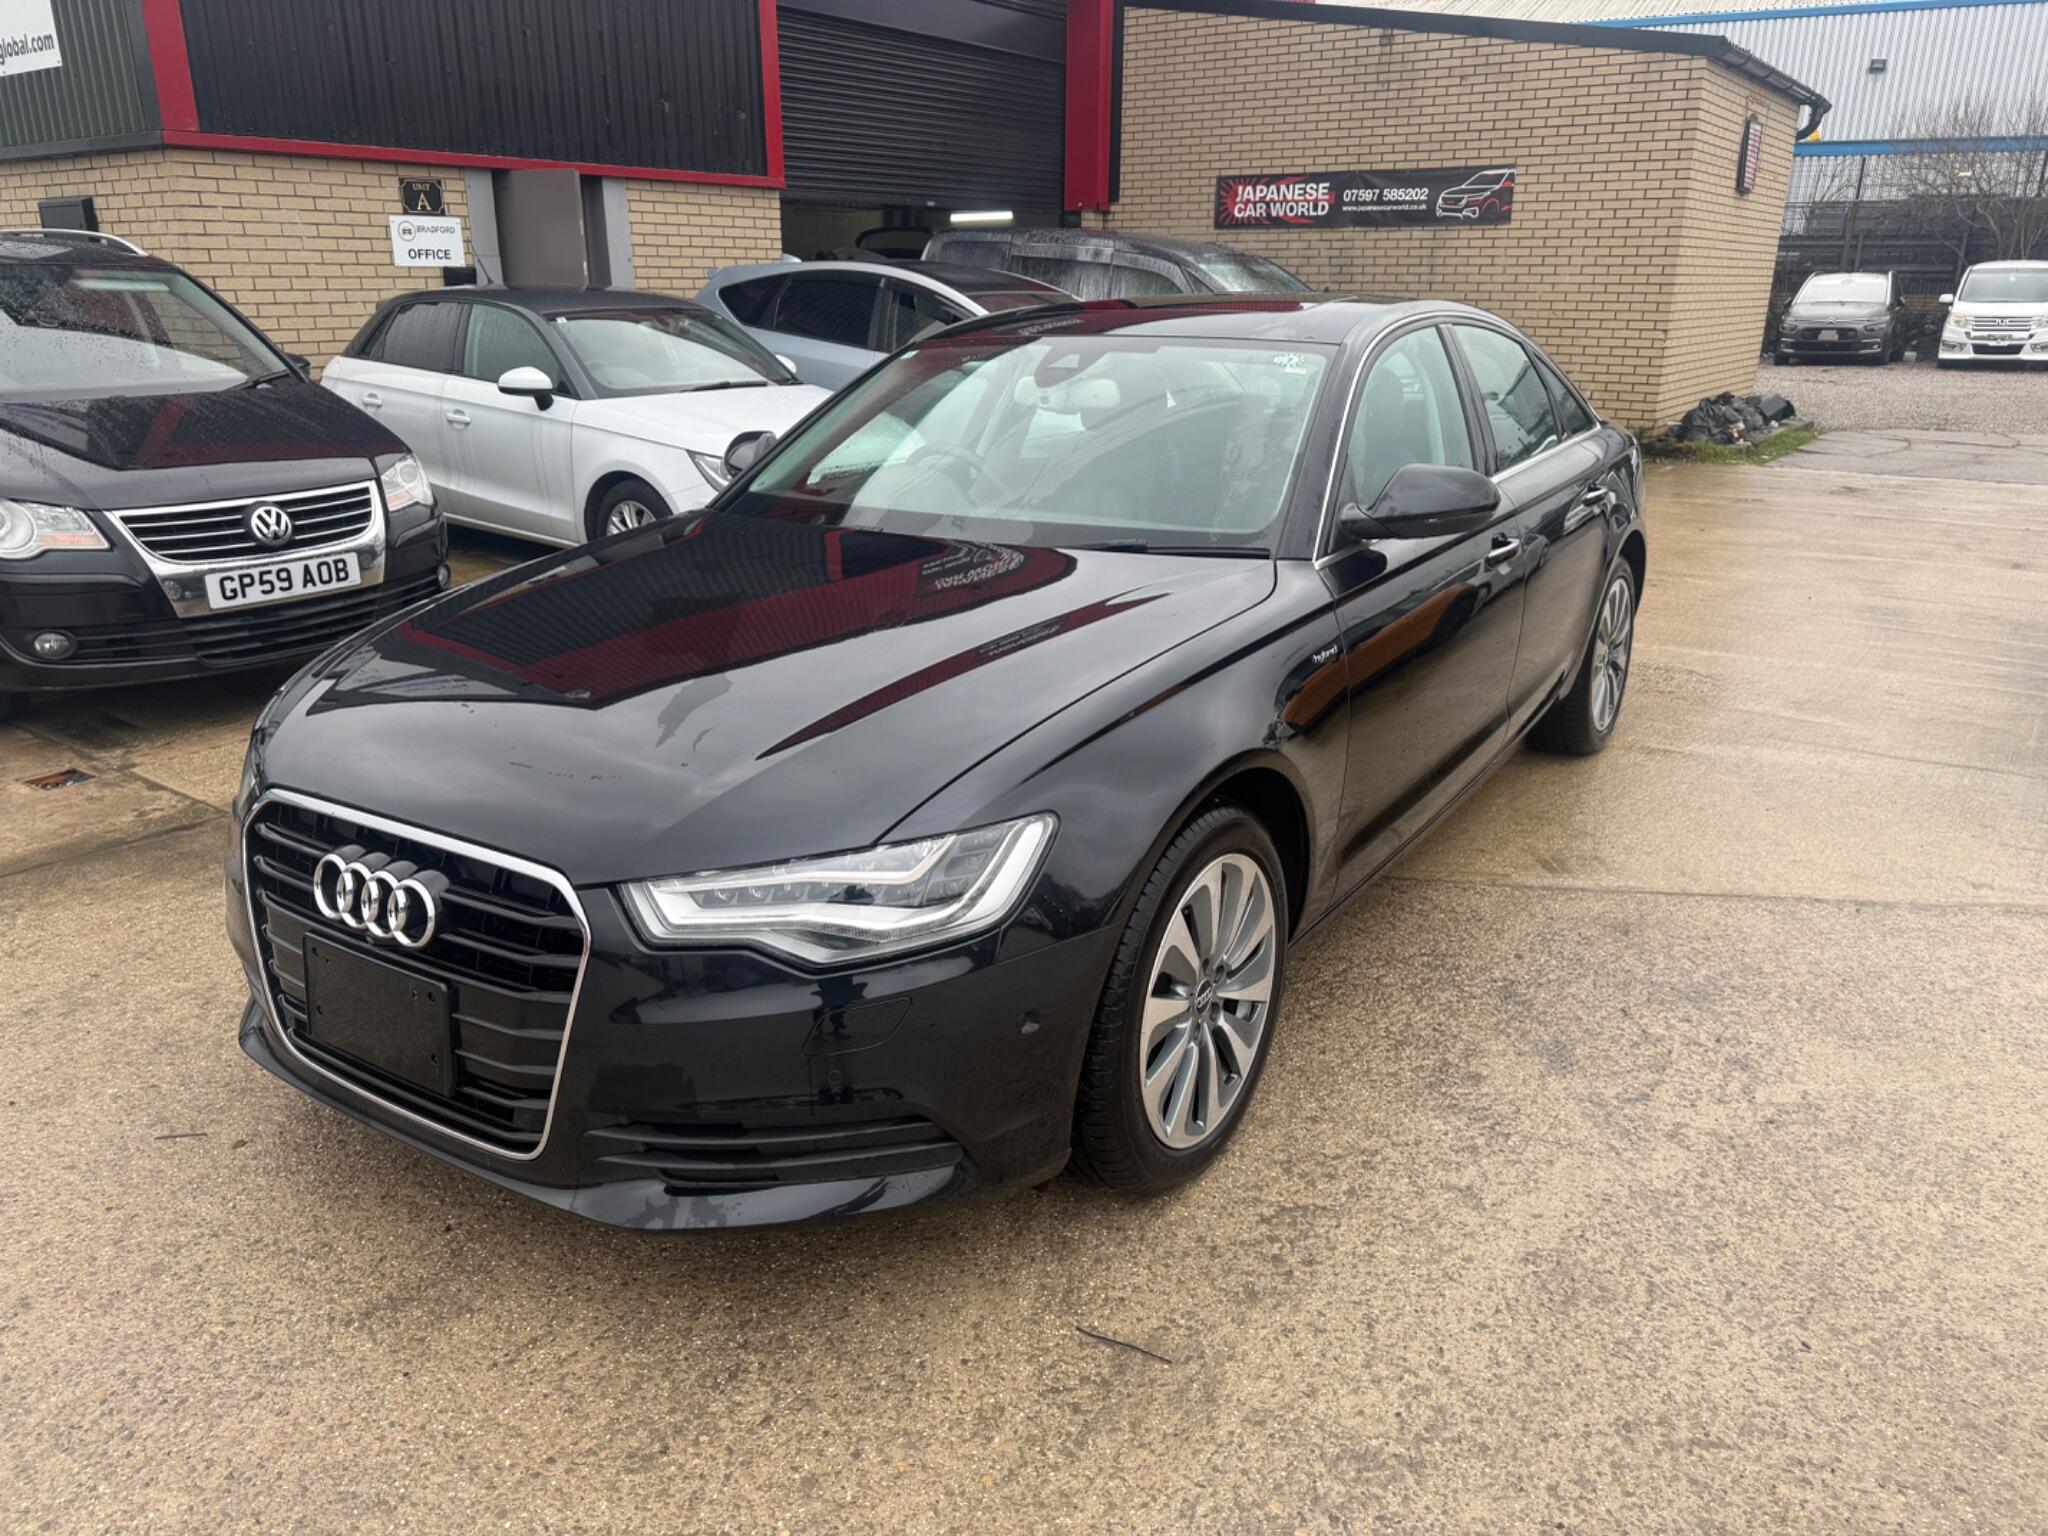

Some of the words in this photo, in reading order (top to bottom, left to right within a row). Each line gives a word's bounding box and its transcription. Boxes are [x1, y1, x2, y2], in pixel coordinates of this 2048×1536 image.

[412, 183, 431, 191] UNIT
[1236, 182, 1330, 202] JAPANESE
[416, 192, 432, 210] A
[1343, 189, 1379, 202] 07597
[1382, 188, 1429, 200] 585202
[1234, 203, 1267, 218] CAR
[1269, 201, 1329, 217] WORLD
[416, 225, 456, 234] BRADFORD
[408, 248, 452, 260] OFFICE
[219, 567, 293, 601] GP59
[302, 558, 349, 588] AOB
